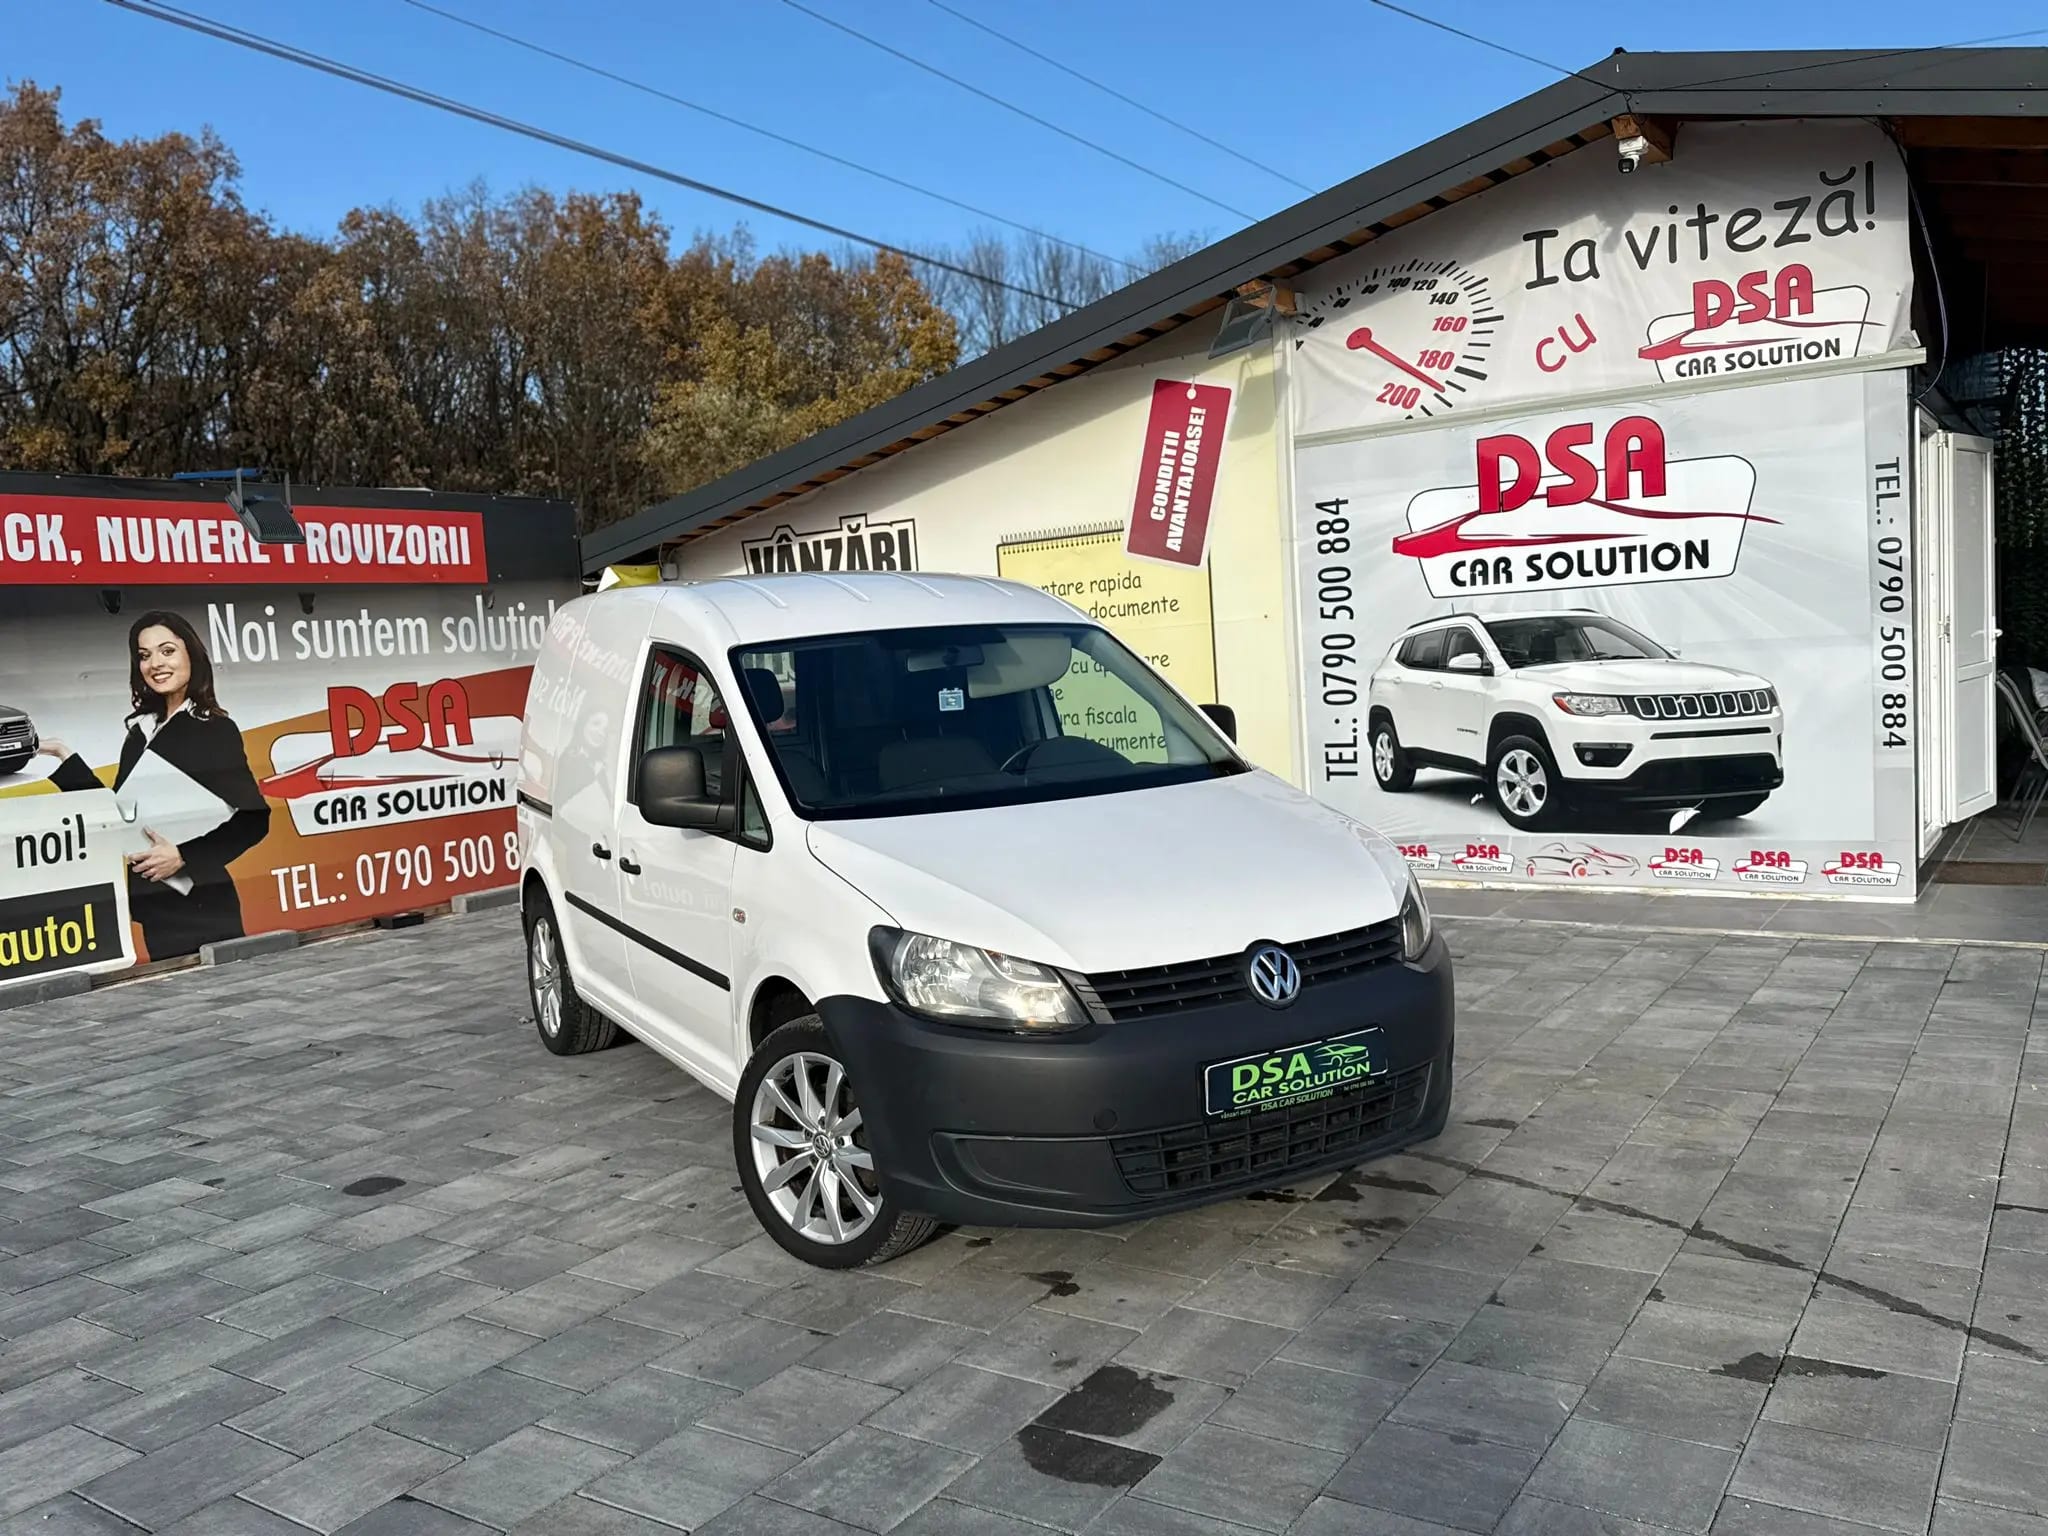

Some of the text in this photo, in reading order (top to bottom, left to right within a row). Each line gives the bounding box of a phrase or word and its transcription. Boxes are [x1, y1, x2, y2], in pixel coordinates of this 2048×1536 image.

[1625, 160, 1875, 270] viteză!
[1387, 277, 1411, 289] 100
[1411, 279, 1438, 291] 120
[1692, 263, 1814, 330] DSA
[1429, 291, 1459, 305] 140
[1431, 316, 1468, 332] 160
[1536, 313, 1597, 373] cu
[1416, 350, 1455, 370] 180
[1675, 337, 1841, 378] CAR SOLUTION
[1376, 382, 1421, 409] 200
[1476, 415, 1666, 514] DSA
[1166, 407, 1206, 552] AVANTAJOASE!
[750, 523, 913, 574] VÂNZĂRI
[1450, 539, 1710, 587] CAR SOLUTION
[1090, 570, 1142, 598] rapida
[1089, 596, 1180, 619] documente
[1875, 456, 1907, 748] TEL.: 0790 500 884
[207, 603, 279, 664] Noi
[292, 609, 430, 660] suntem
[1315, 498, 1358, 782] TEL.: 0790 500 884
[1071, 661, 1088, 674] cu
[327, 678, 473, 757] DSA
[1085, 706, 1137, 726] fiscala
[313, 778, 505, 825] CAR SOLUTION
[15, 814, 87, 869] noi!
[1466, 844, 1500, 859] DSA
[1475, 865, 1508, 873] SOLUTION
[1664, 847, 1703, 865] DSA
[1750, 850, 1790, 868] DSA
[1840, 852, 1883, 869] DSA
[271, 863, 347, 912] TEL.:
[356, 844, 432, 896] 0790
[443, 834, 495, 882] 500
[1658, 869, 1711, 879] CAR SOLUTION
[1744, 873, 1799, 883] CAR SOLUTION
[1834, 875, 1892, 885] CAR SOLUTION
[0, 903, 97, 966] auto!
[1232, 1052, 1312, 1092] DSA
[1233, 1086, 1273, 1105] CAR
[1279, 1061, 1370, 1094] SOLUTION
[1260, 1089, 1334, 1112] DSA CAR SOLUTION
